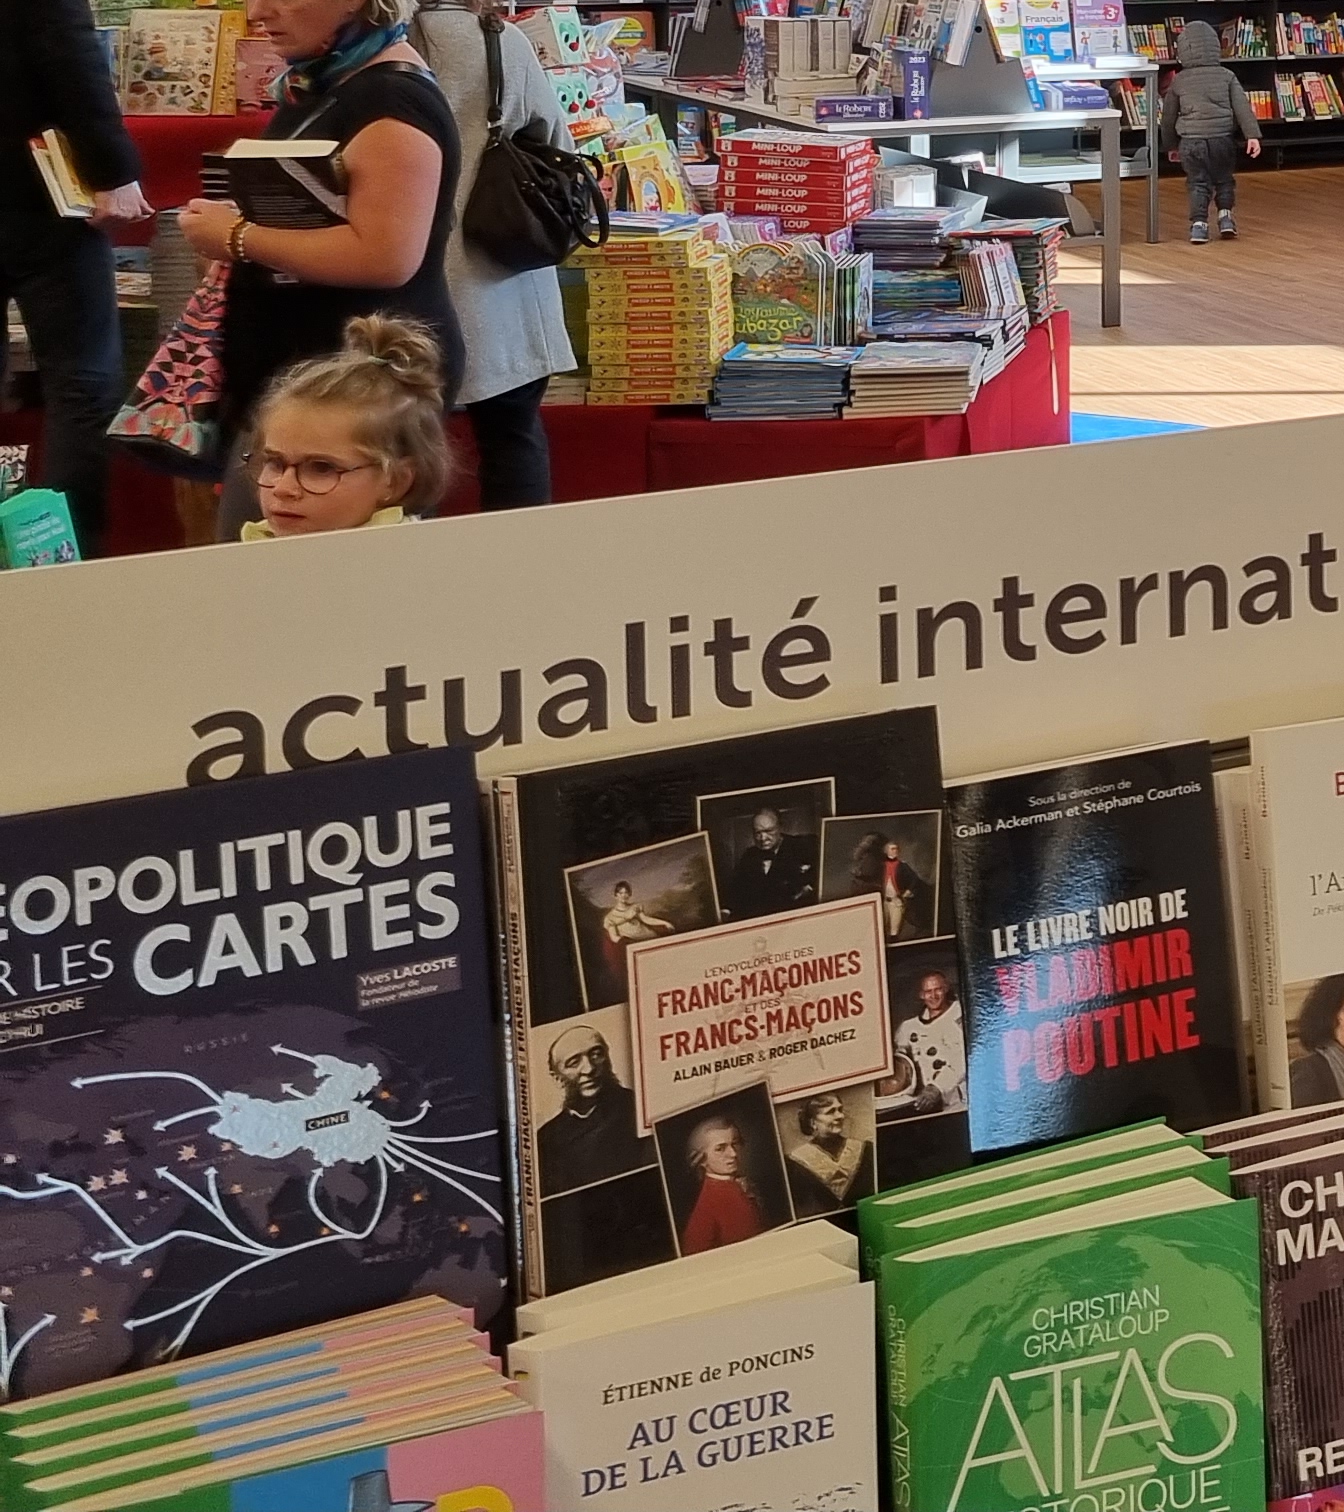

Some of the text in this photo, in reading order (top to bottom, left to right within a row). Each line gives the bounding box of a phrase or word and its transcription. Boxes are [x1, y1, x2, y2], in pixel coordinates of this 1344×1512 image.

[1025, 14, 1064, 25] Français
[755, 172, 808, 183] MINI-LOUP
[758, 158, 810, 168] MINI-LOUP
[185, 593, 833, 788] actualité
[0, 802, 454, 942] OPOLITIQUE
[32, 871, 461, 996] LES CARTES
[991, 888, 1189, 959] LE LIVRE NOIR DE
[657, 950, 862, 1018] FRANC-MAÇONNES
[996, 927, 1194, 1017] VLADIMIR
[660, 990, 864, 1061] FRANCS-MAÇONS
[673, 1028, 856, 1083] ALAIN BAUER ROGER DACHEZ
[1001, 987, 1201, 1092] POUTINE
[1023, 1308, 1171, 1358] GRATALOUP
[1032, 1284, 1161, 1332] CHRISTIAN
[946, 1331, 1238, 1512] ATLAS
